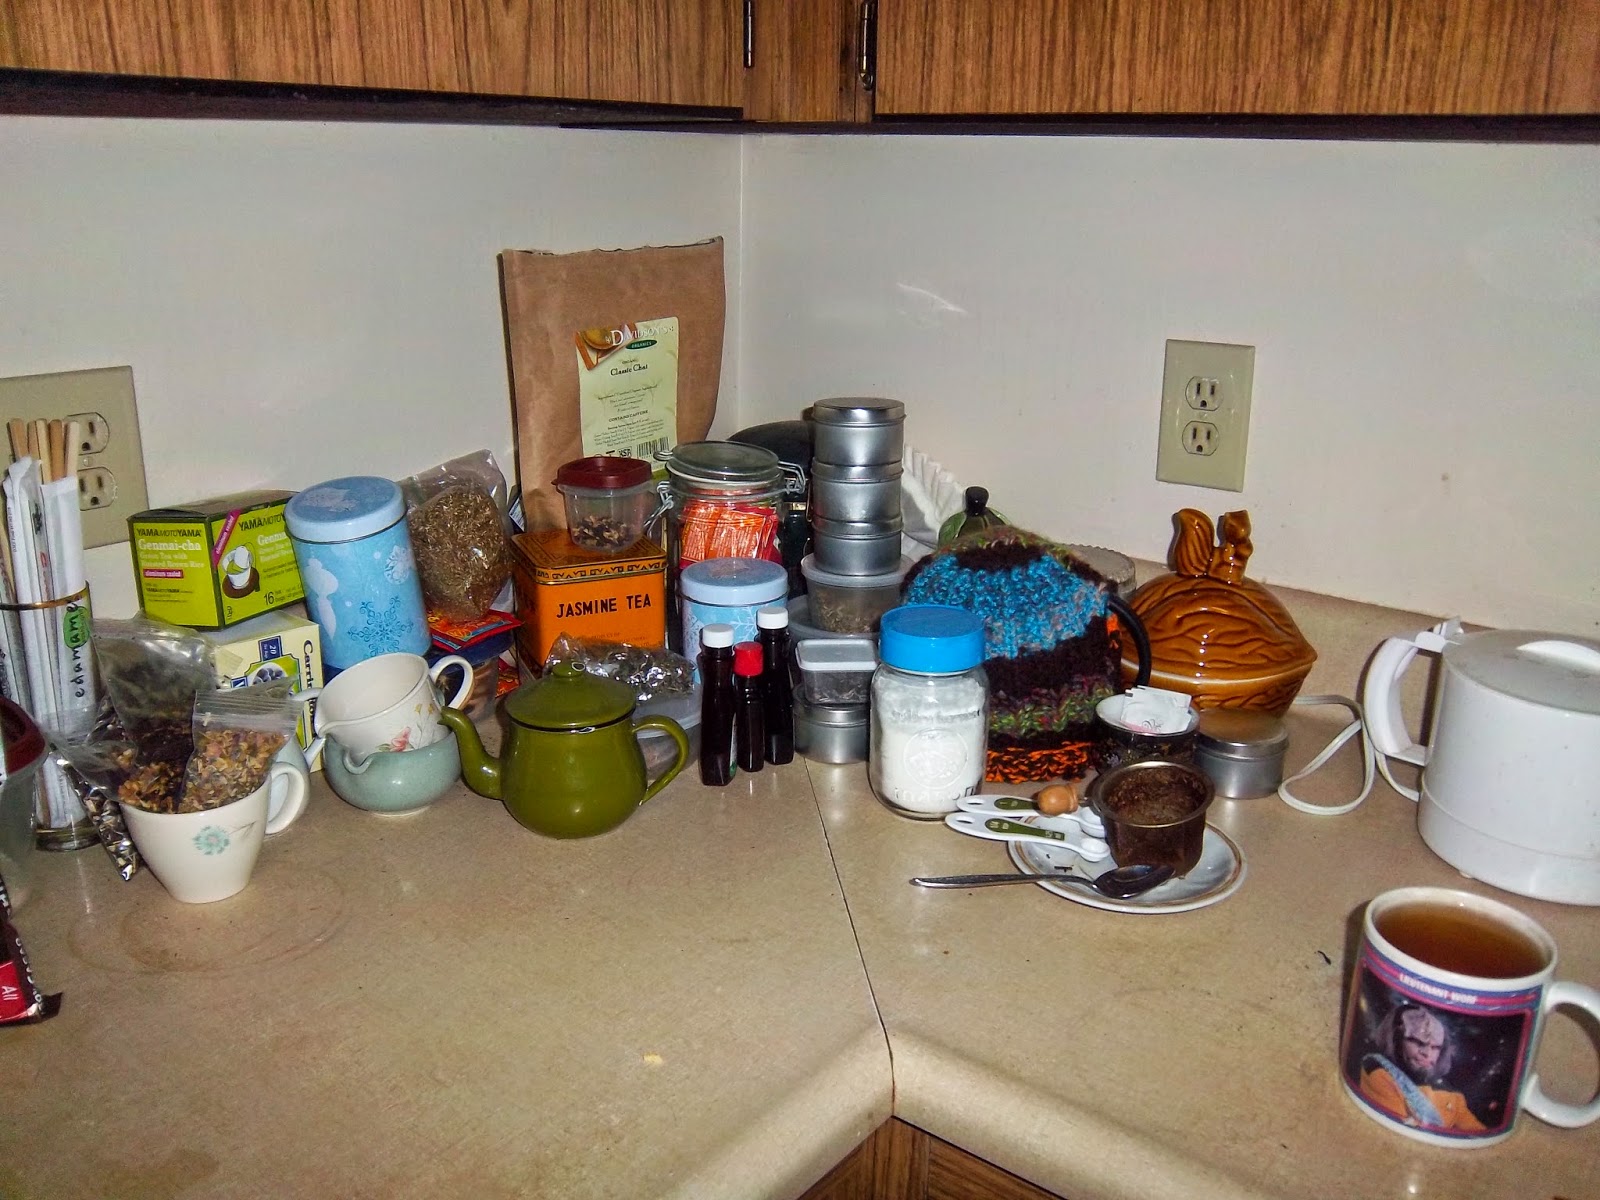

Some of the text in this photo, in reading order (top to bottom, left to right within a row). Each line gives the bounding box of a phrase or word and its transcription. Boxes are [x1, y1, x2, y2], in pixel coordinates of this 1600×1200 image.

[610, 363, 648, 376] Classic Chai
[136, 528, 202, 538] YAMAMOTOYAMA
[138, 538, 202, 551] Genmai-cha
[263, 591, 275, 606] 16
[556, 593, 651, 619] JASMINE TEA
[68, 602, 85, 697] edamame
[269, 644, 277, 655] 20
[1, 985, 19, 1001] All
